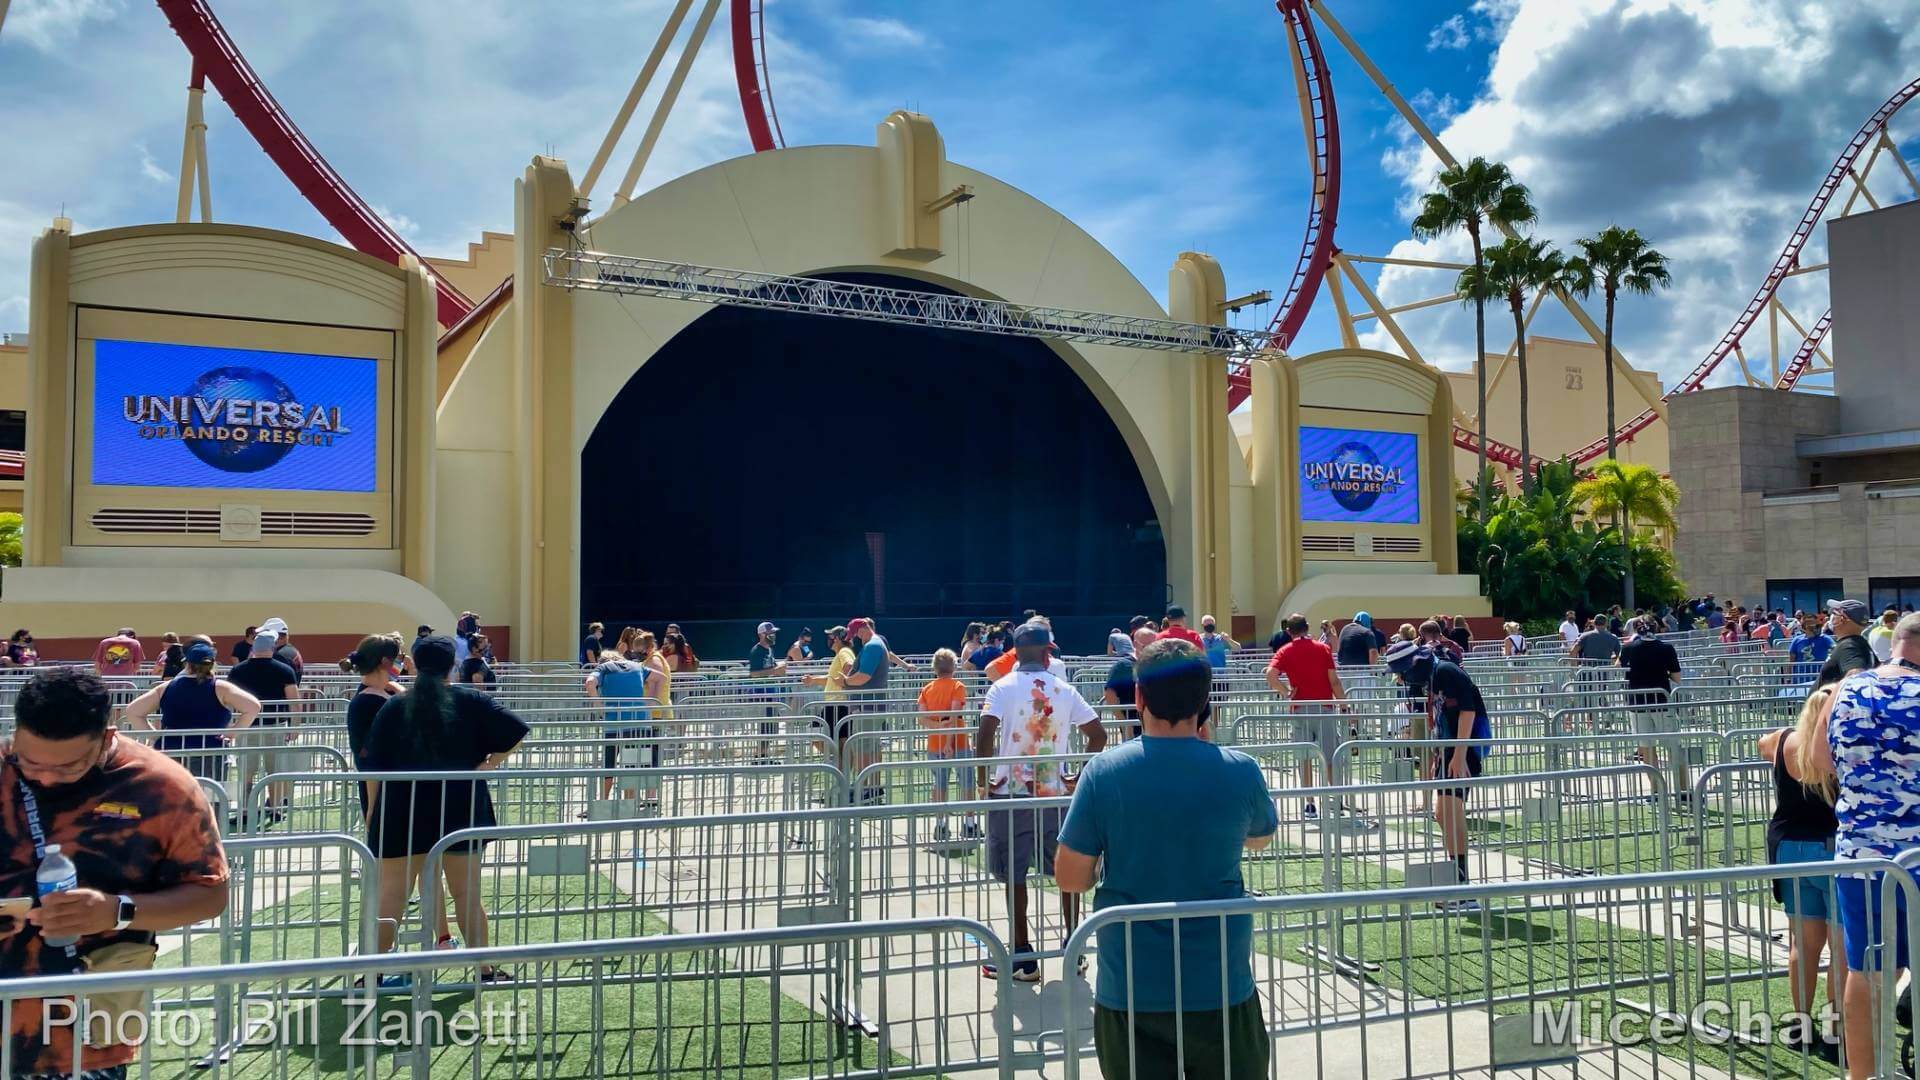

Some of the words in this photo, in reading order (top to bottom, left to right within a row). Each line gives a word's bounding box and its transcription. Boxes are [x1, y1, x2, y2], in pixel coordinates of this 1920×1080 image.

[1565, 373, 1584, 391] 23
[122, 395, 350, 434] UNIVERSAL
[139, 425, 249, 442] ORLANDO
[257, 428, 334, 447] RESORT
[1304, 462, 1405, 485] UNIVERSAL
